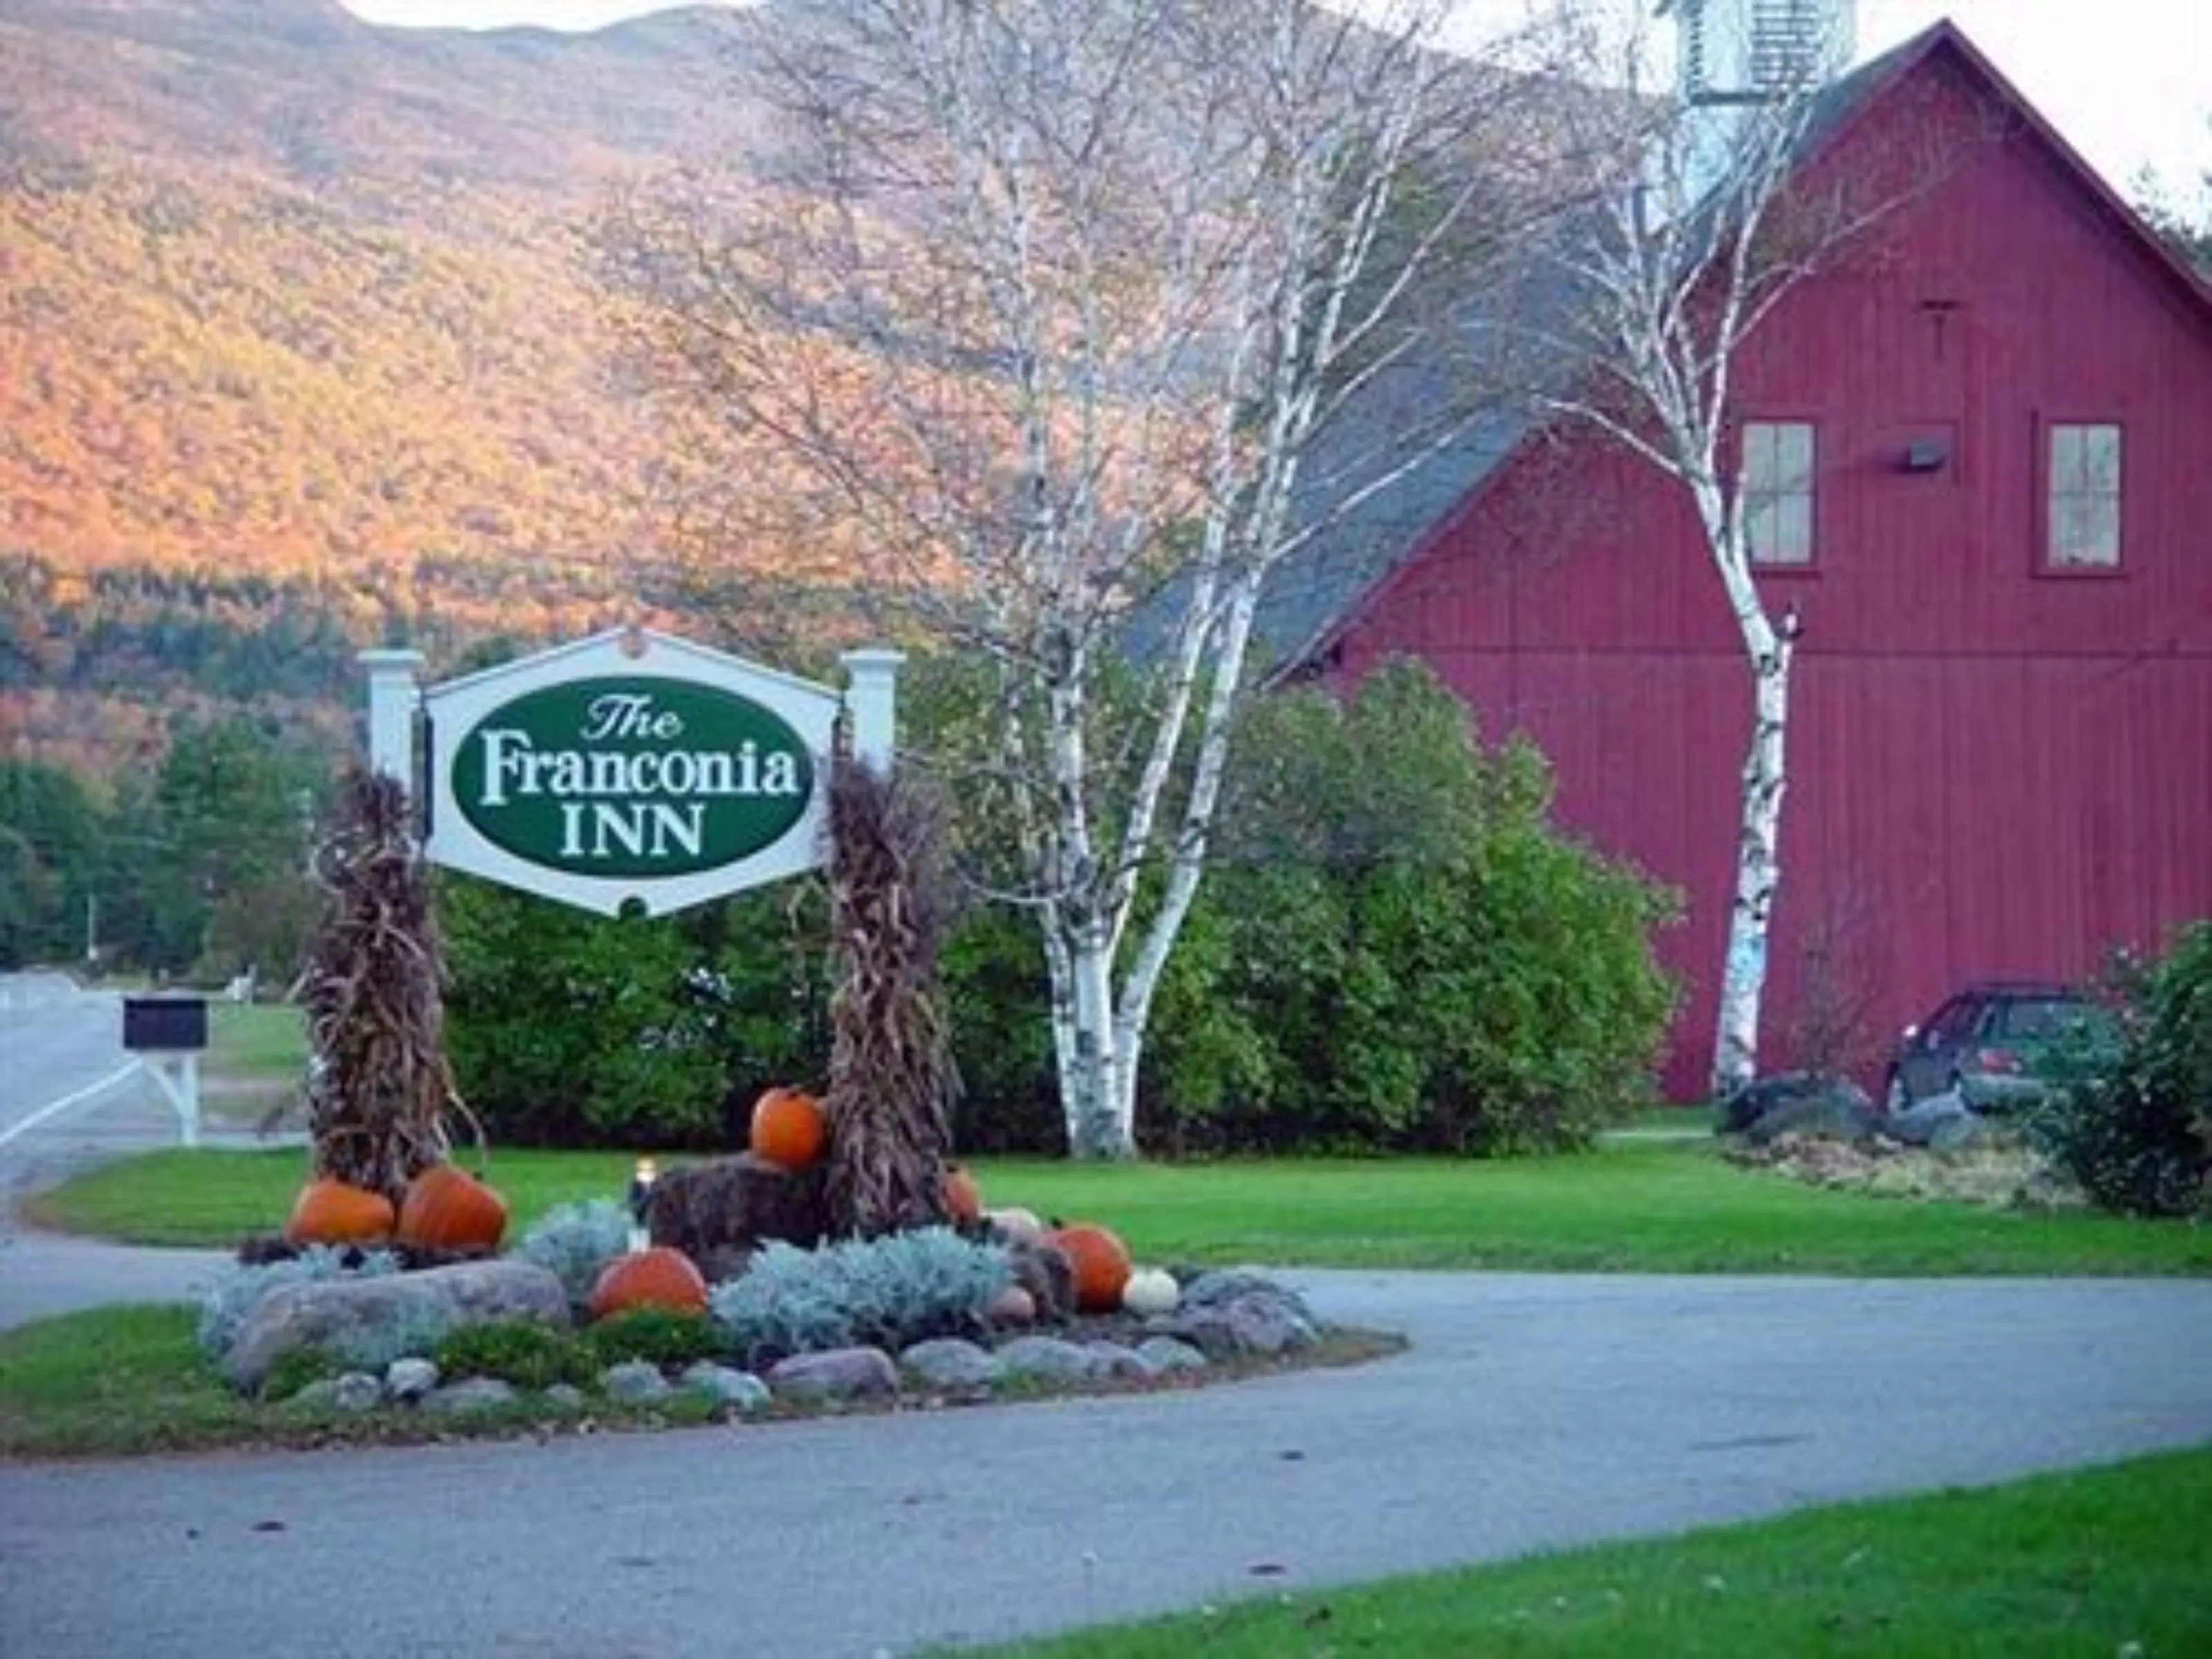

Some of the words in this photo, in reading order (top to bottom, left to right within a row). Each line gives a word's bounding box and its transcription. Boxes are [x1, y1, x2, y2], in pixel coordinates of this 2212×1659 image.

[581, 693, 684, 740] The
[478, 729, 800, 807] Franconia
[561, 803, 705, 856] INN
